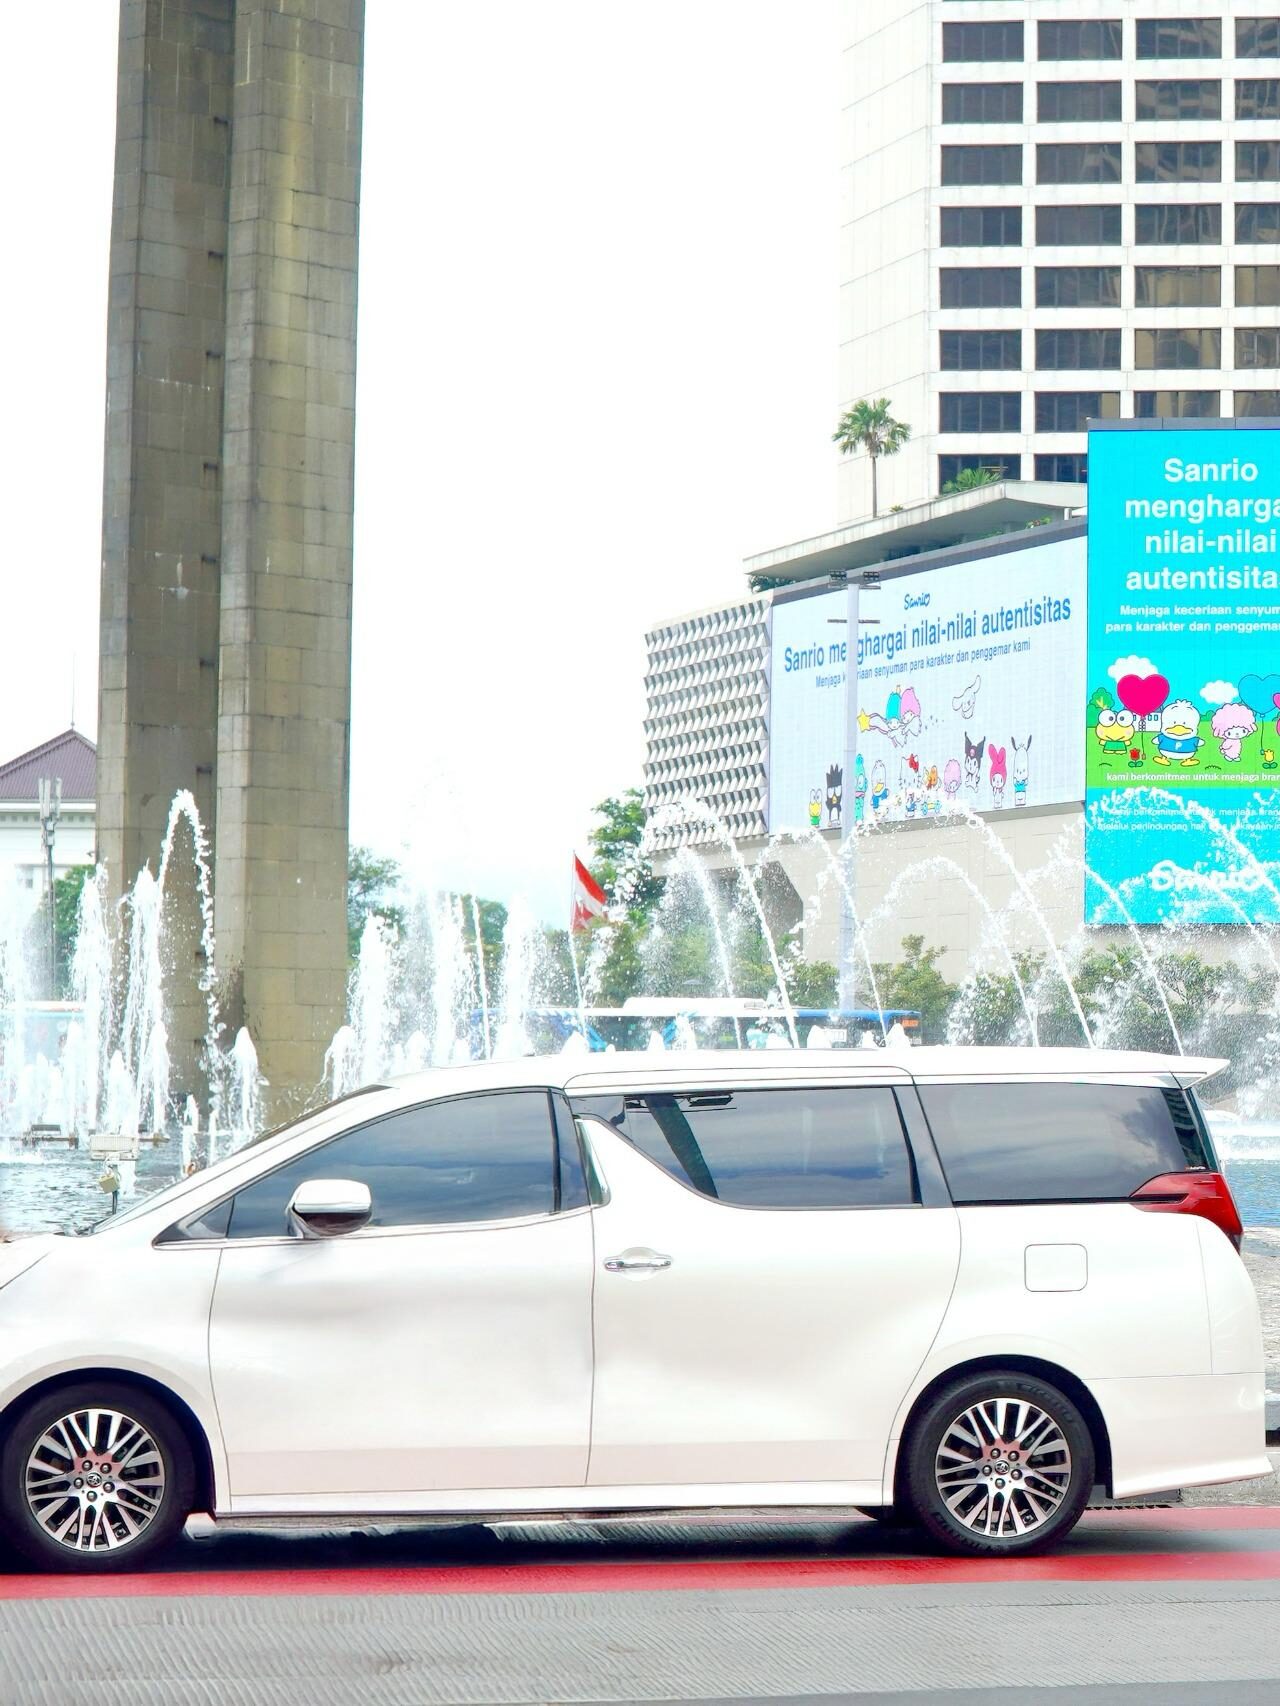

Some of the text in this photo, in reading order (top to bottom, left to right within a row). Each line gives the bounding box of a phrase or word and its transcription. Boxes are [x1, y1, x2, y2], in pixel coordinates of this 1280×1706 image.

[1164, 458, 1258, 483] Sanrio
[1145, 529, 1277, 554] nilai-nilai
[1120, 605, 1170, 616] Menjaga
[1174, 605, 1231, 615] keceriaan
[784, 595, 1071, 673] Sanrio meghargai nilai-nilai autentisitas
[1105, 623, 1132, 634] para
[1136, 621, 1184, 632] karakter
[1189, 621, 1211, 631] dan
[874, 661, 908, 678] senyuman
[909, 658, 924, 673] para
[926, 652, 954, 669] karakter
[956, 649, 969, 664] dan
[971, 642, 1012, 663] penggemar
[1013, 637, 1031, 652] kami
[1107, 772, 1128, 781] kami
[1131, 772, 1190, 781] berkomitmen
[1193, 773, 1219, 781] untuk
[1222, 773, 1259, 783] menjaga
